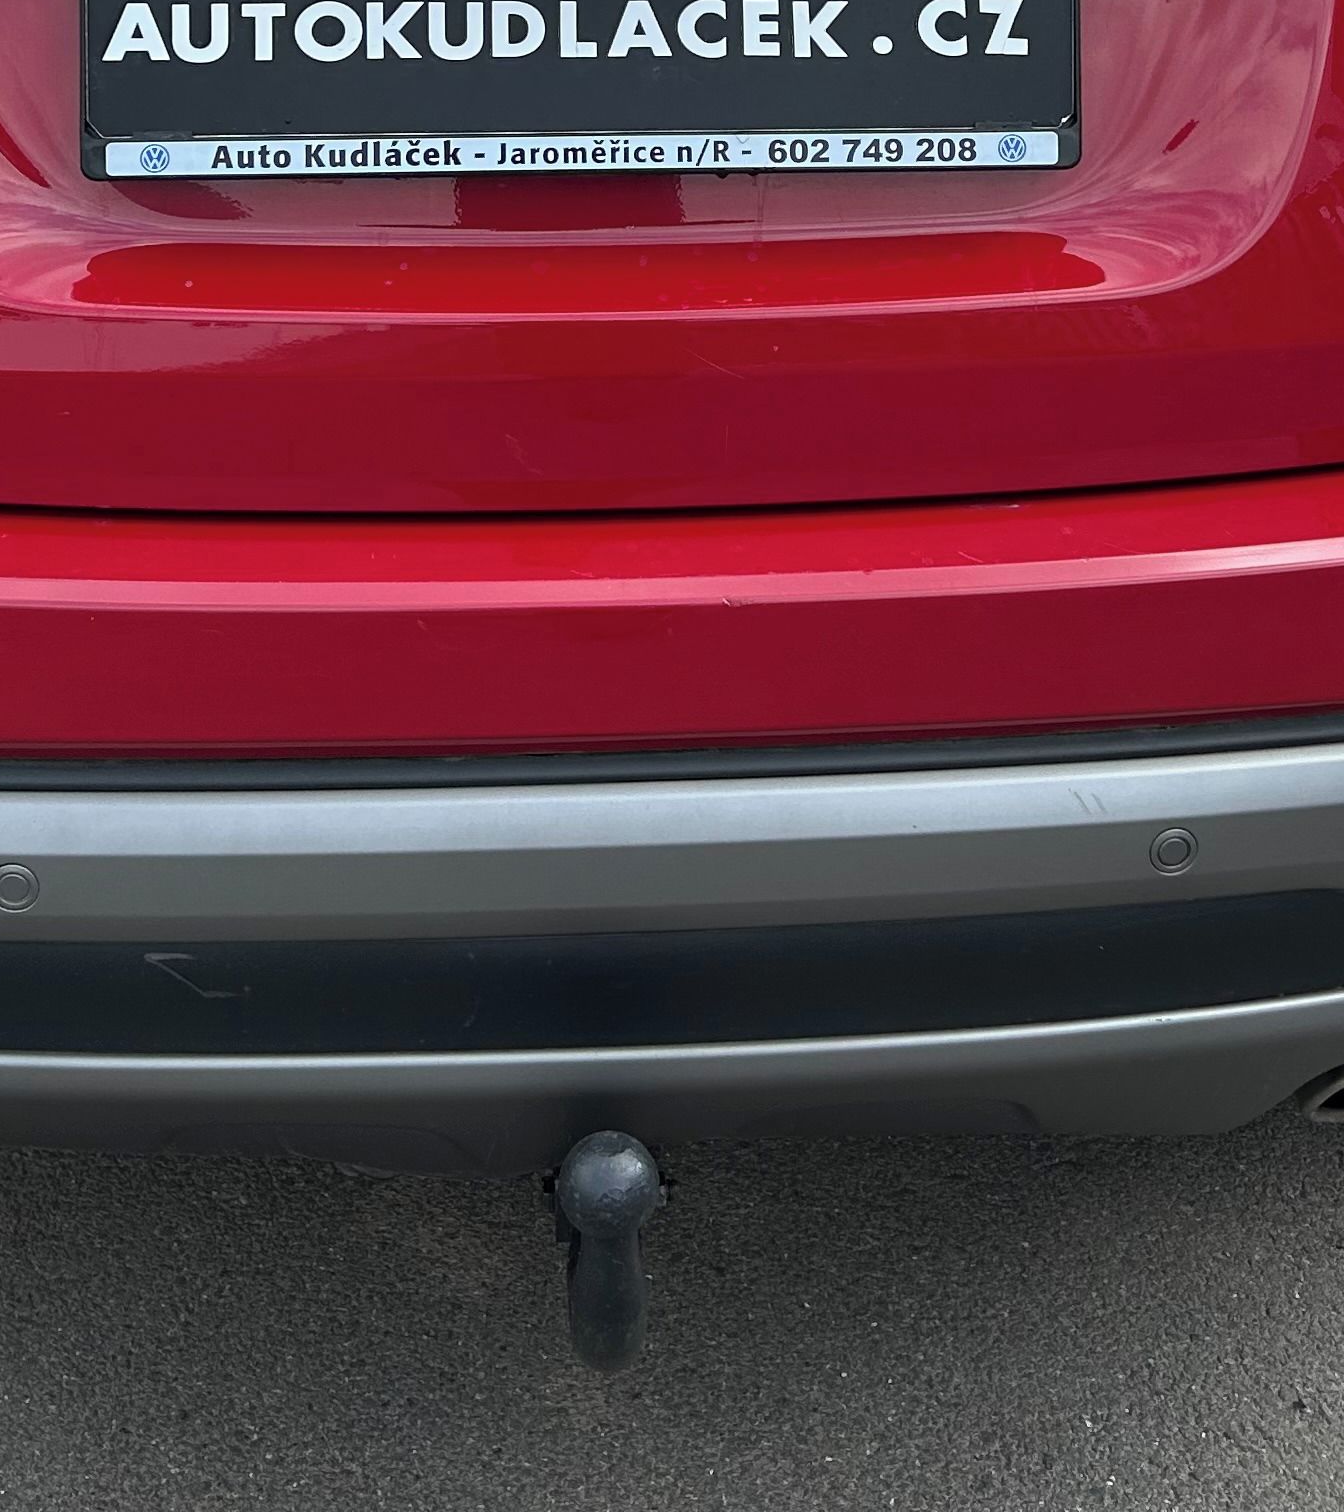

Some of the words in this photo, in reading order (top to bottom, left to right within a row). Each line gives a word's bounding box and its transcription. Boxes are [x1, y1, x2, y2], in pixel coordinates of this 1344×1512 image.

[211, 144, 292, 169] Auto
[304, 140, 462, 168] Kudláček
[497, 139, 665, 165] Jaroměřice
[677, 138, 731, 167] n/R
[768, 138, 830, 164] 602
[842, 138, 904, 163] 749
[915, 137, 977, 163] 208
